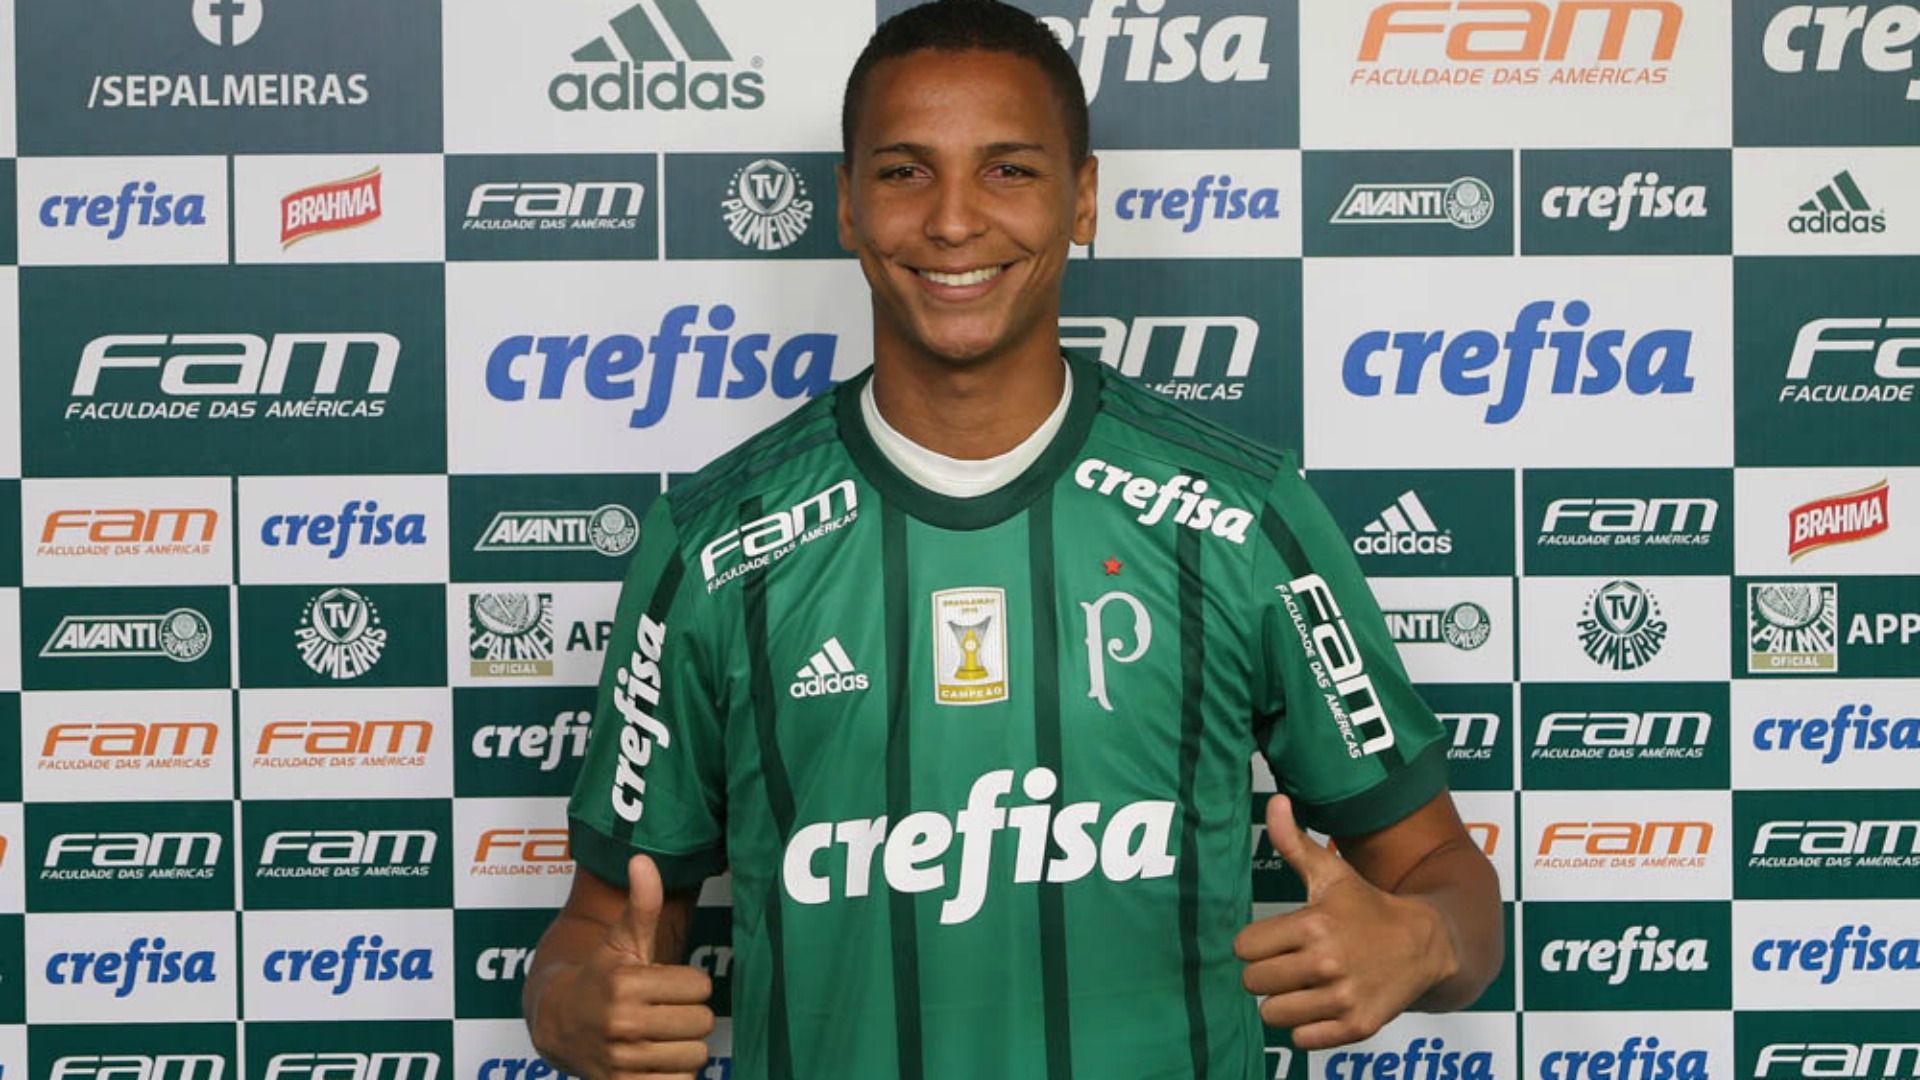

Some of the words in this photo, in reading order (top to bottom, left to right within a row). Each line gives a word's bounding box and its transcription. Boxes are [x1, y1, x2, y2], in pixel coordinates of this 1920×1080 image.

[88, 74, 369, 109] /SEPALMEIRAS
[548, 61, 765, 111] adidas
[1350, 68, 1483, 86] FACULDADE
[1492, 68, 1539, 84] DAS
[750, 174, 785, 200] TV
[1344, 190, 1441, 216] AVANTI
[1541, 172, 1708, 231] crefisa
[39, 181, 206, 240] crefisa
[285, 184, 378, 231] BRAHMA
[1115, 175, 1280, 233] crefisa
[462, 219, 537, 230] FACULDADE
[540, 219, 566, 230] DAS
[721, 198, 815, 251] PALMEIRAS
[1787, 211, 1886, 234] adidas
[485, 304, 838, 428] crefisa
[1341, 300, 1695, 425] crefisa
[65, 401, 200, 420] FACULDADE
[208, 401, 257, 418] DAS
[265, 396, 386, 418] AMÉRICAS
[1779, 384, 1915, 402] FACULDADE
[1074, 458, 1255, 544] crefisa
[261, 500, 427, 559] crefisa
[489, 518, 587, 544] AVANTI
[1795, 496, 1884, 544] BRAHMA
[36, 546, 110, 557] FACULDADE
[115, 545, 141, 556] DAS
[1353, 531, 1452, 555] adidas
[1537, 534, 1610, 545] FACULDADE
[1615, 534, 1642, 545] DAS
[707, 555, 771, 595] FACULDADE
[324, 603, 360, 628] TV
[1275, 584, 1316, 658] FACULDADE
[1605, 595, 1639, 620] TV
[54, 623, 156, 649] AVANTI
[1576, 617, 1668, 671] PALMEIRAS
[1846, 613, 1920, 645] APP
[294, 626, 388, 680] PALMEIRAS
[489, 663, 538, 674] OFICIAL
[1770, 656, 1820, 667] OFICIAL
[790, 672, 870, 699] adidas
[612, 613, 671, 822] crefisa
[1752, 704, 1920, 764] crefisa
[472, 711, 593, 771] crefi
[1531, 748, 1604, 758] FACULDADE
[1608, 748, 1634, 758] DAS
[38, 758, 110, 769] FACULDADE
[115, 757, 141, 768] DAS
[253, 756, 326, 767] FACULDADE
[330, 756, 356, 767] DAS
[783, 767, 1177, 925] crefisa
[1748, 857, 1821, 868] FACULDADE
[1825, 857, 1852, 868] DAS
[40, 869, 114, 880] FACULDADE
[118, 868, 144, 880] DAS
[256, 867, 330, 878] FACULDADE
[334, 867, 360, 878] DAS
[471, 865, 543, 876] FACULDADE
[1534, 858, 1607, 868] FACULDADE
[1611, 858, 1637, 868] DAS
[46, 937, 217, 998] crefisa
[262, 935, 434, 995] crefisa
[1540, 926, 1709, 985] crefisa
[1752, 925, 1920, 985] crefisa
[1325, 1038, 1495, 1080] crefisa
[1540, 1037, 1709, 1080] crefisa
